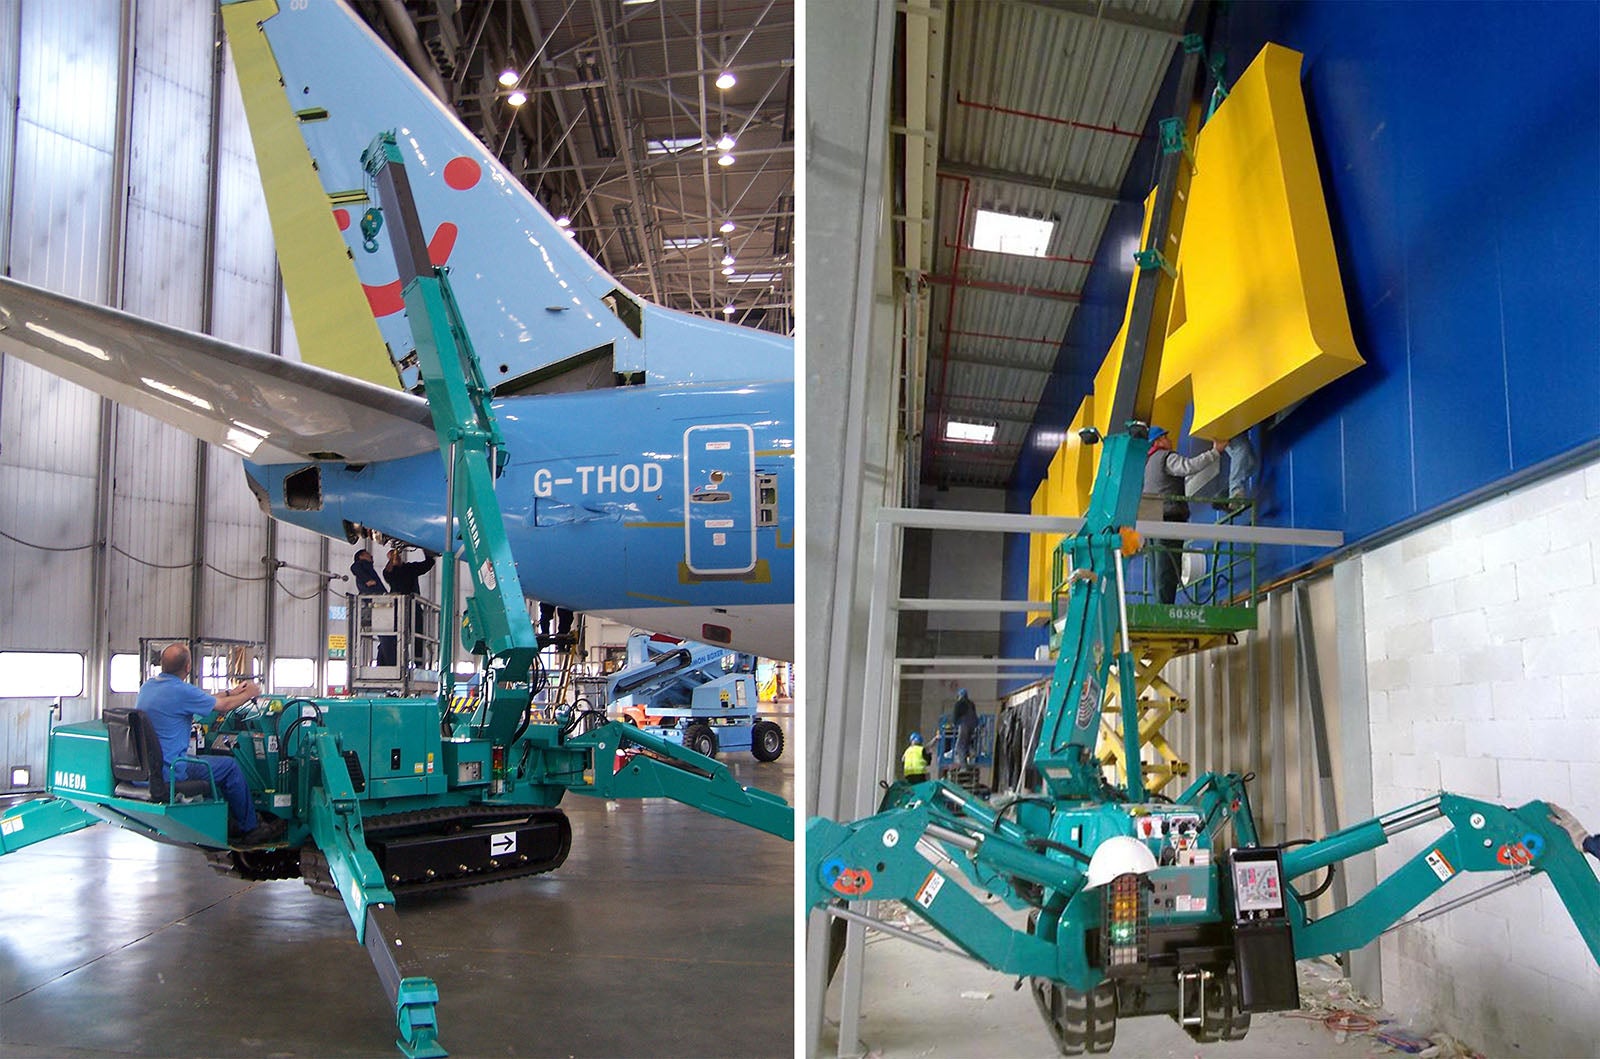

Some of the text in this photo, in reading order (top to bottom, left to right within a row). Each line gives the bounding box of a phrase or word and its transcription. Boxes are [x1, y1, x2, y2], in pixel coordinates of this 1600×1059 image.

[533, 462, 663, 497] G-THOD
[466, 507, 480, 549] MAEDA
[55, 770, 87, 791] MAEDA
